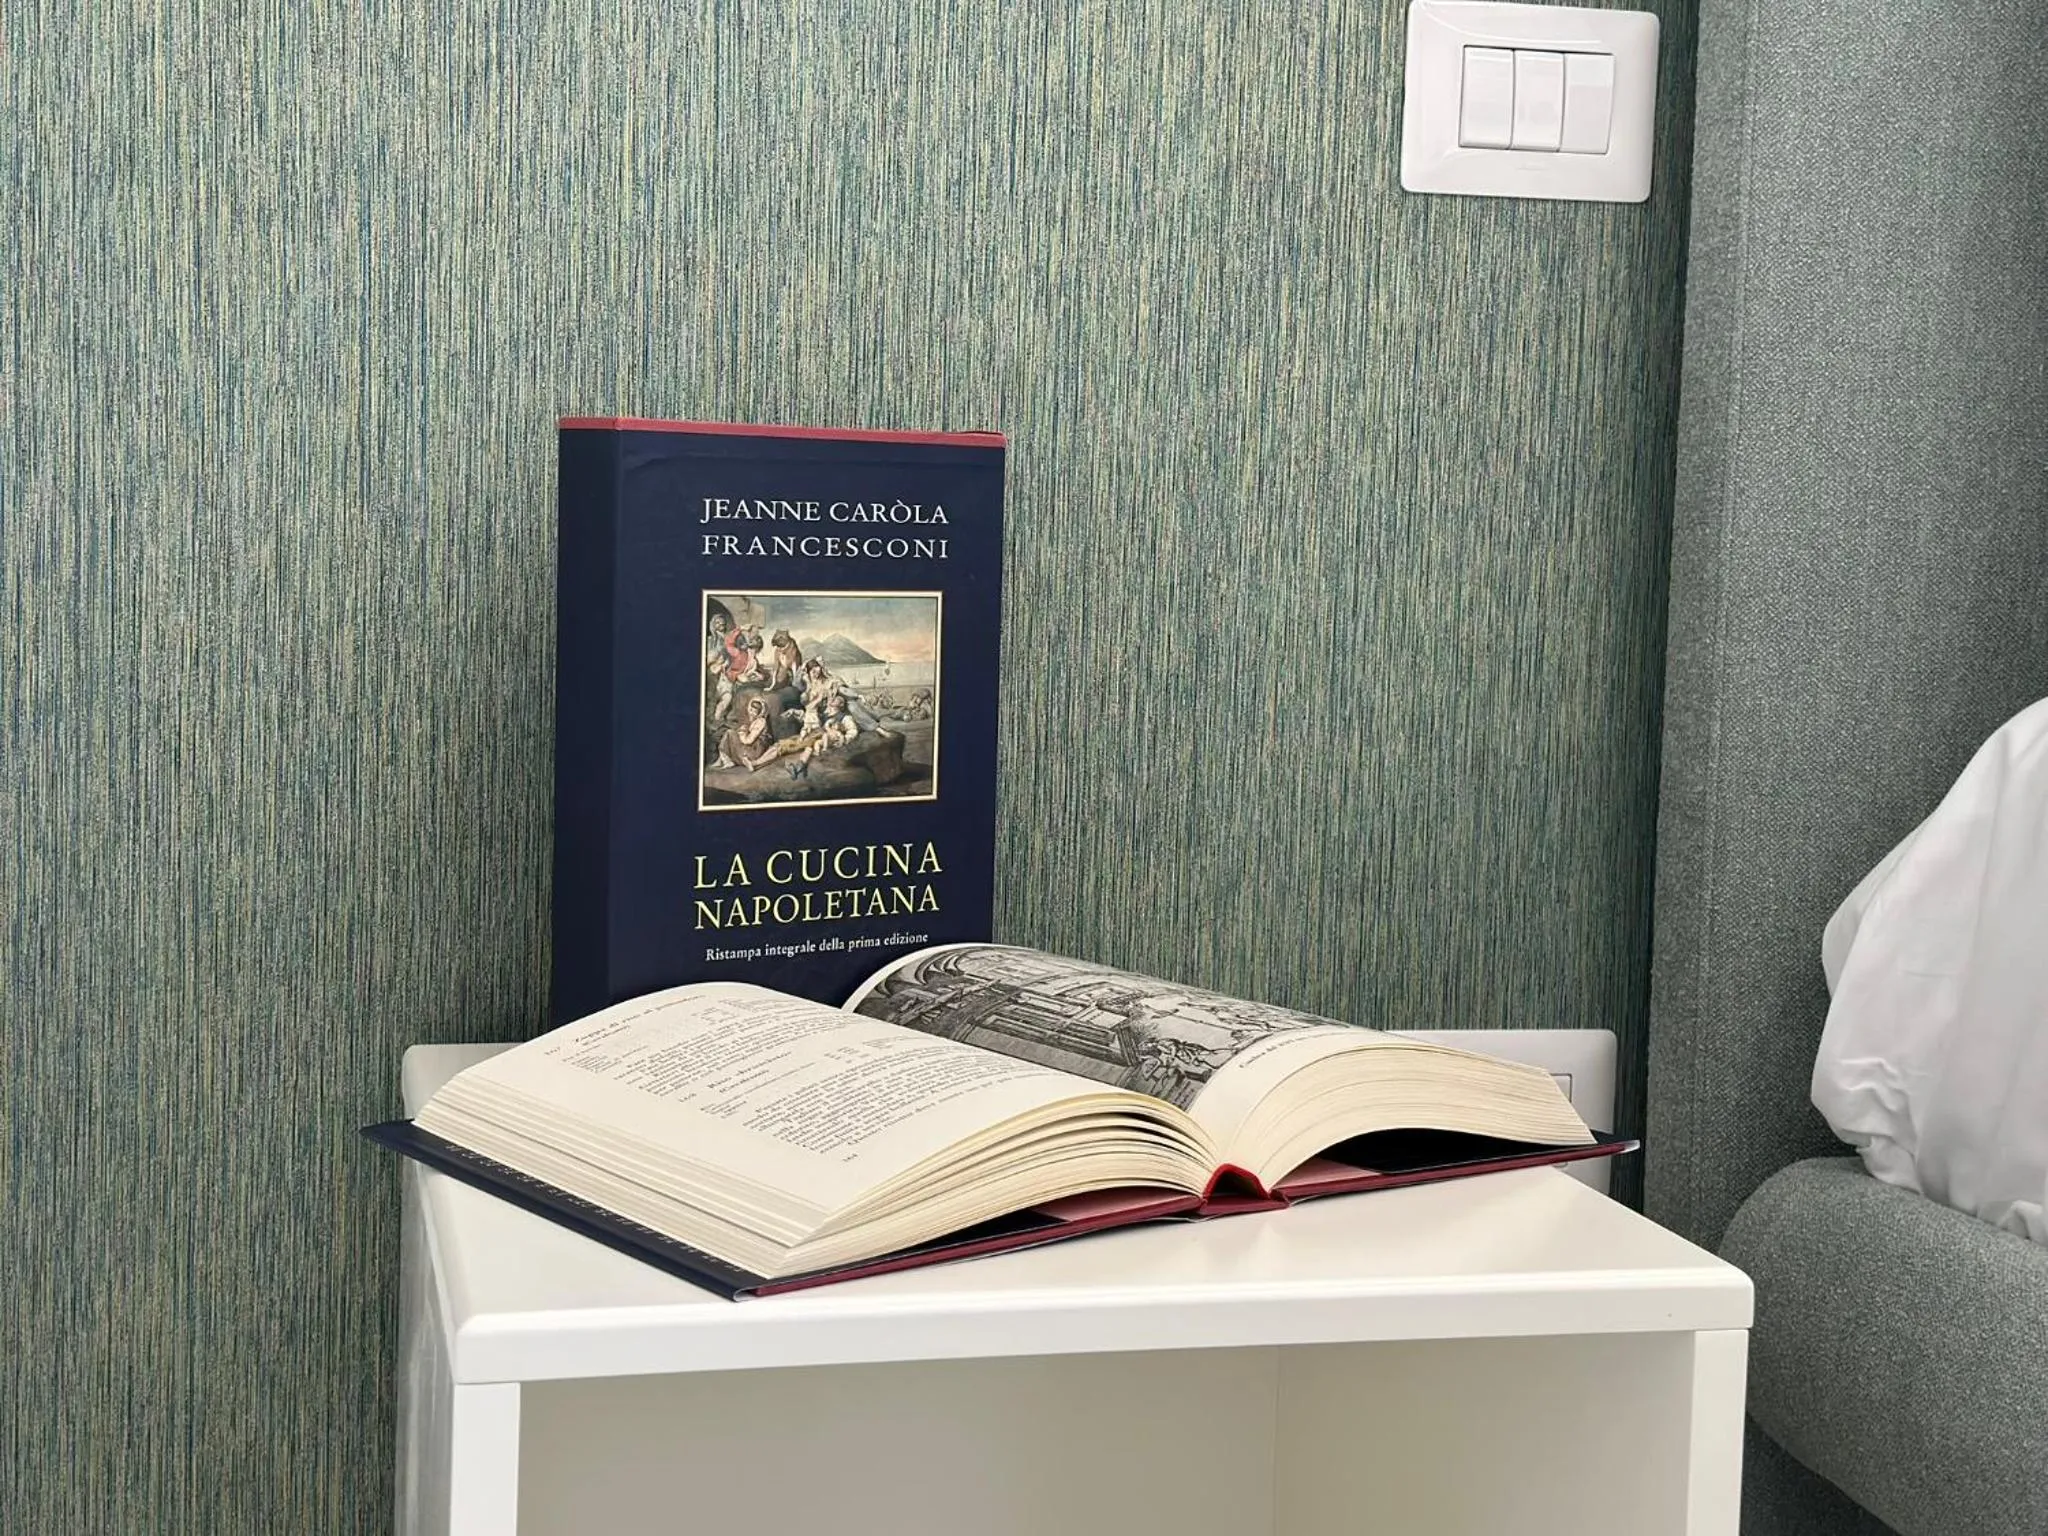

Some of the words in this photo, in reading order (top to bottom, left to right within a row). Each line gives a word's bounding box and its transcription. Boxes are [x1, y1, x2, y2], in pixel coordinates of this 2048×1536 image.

[699, 498, 821, 524] JEANNE
[829, 498, 949, 524] CARÒLA
[701, 534, 948, 559] FRANCESCONI
[693, 853, 752, 889] LA
[766, 841, 943, 884] CUCINA
[694, 884, 940, 930] NAPOLETANA
[705, 946, 762, 963] Ristampa
[765, 939, 816, 959] integrale
[818, 937, 845, 952] della
[848, 935, 881, 953] prima
[883, 931, 928, 947] edizione
